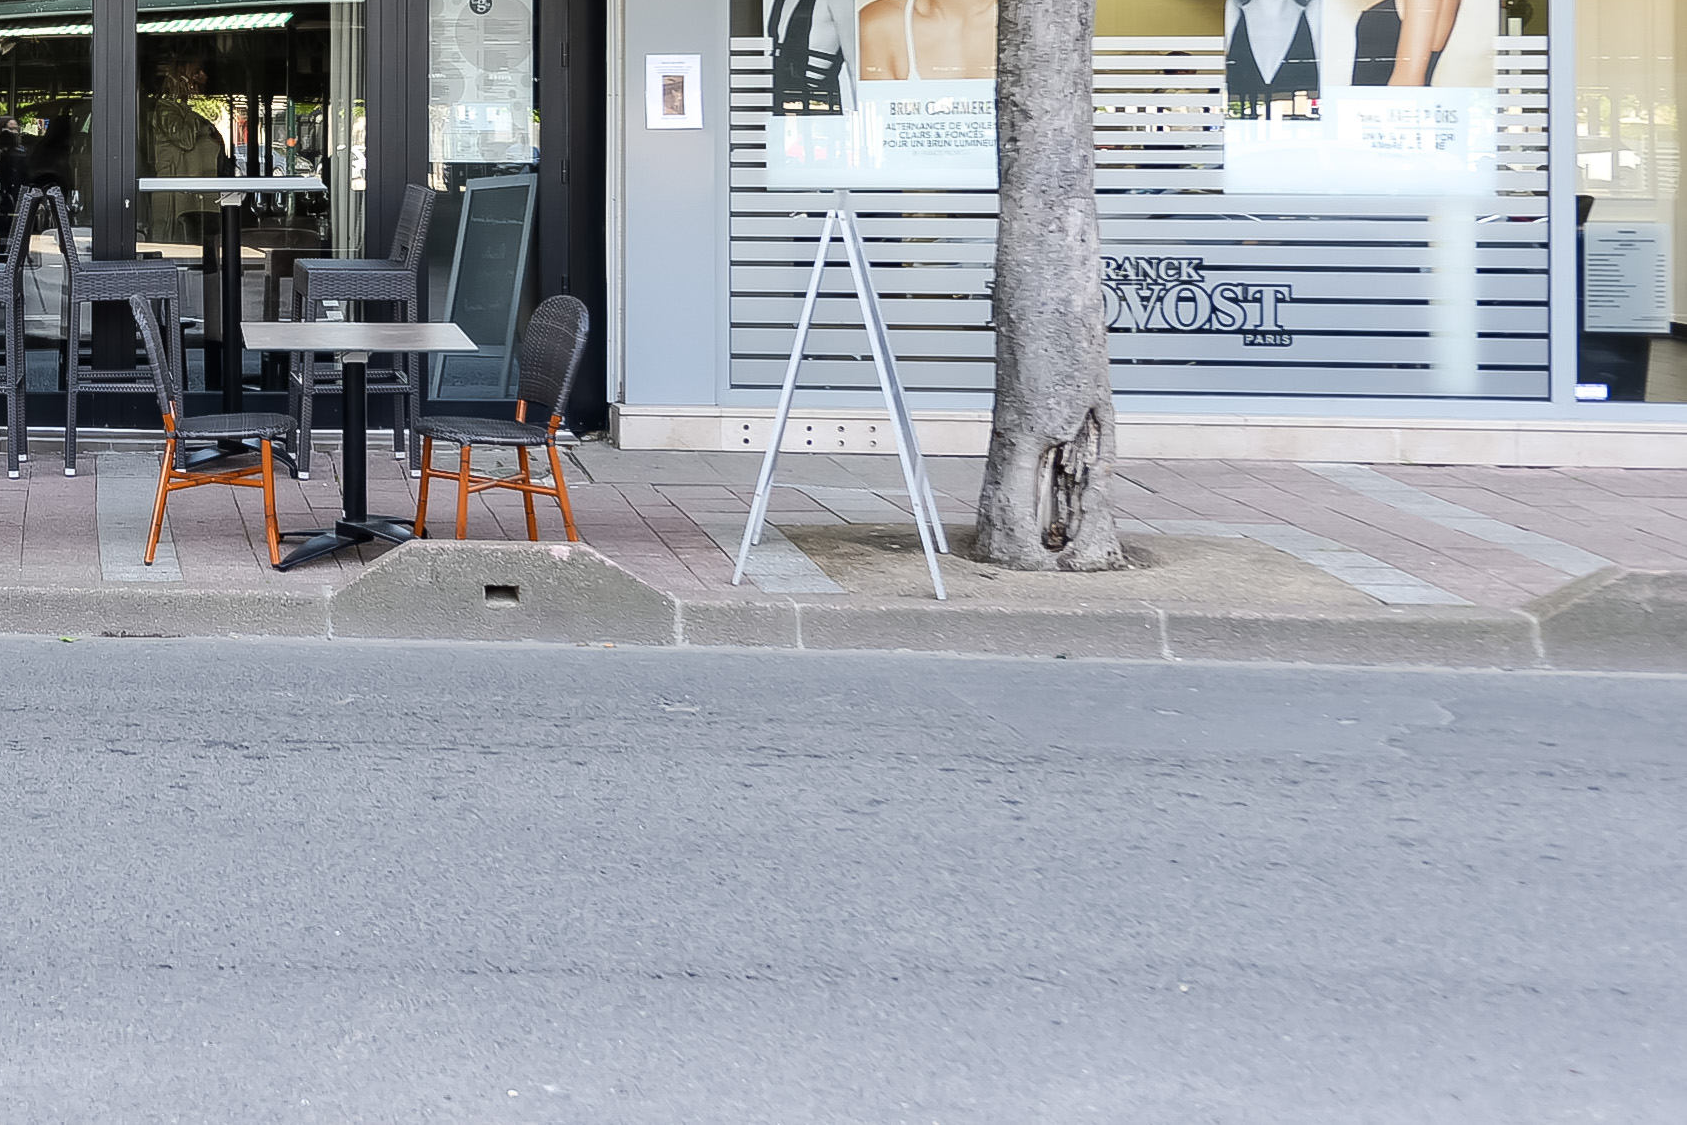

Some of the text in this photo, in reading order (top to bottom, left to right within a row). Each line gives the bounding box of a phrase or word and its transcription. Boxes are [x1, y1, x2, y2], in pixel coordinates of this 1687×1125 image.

[924, 100, 993, 116] CSHMERE
[1100, 257, 1204, 282] RANCK
[1245, 334, 1291, 345] PARIS
